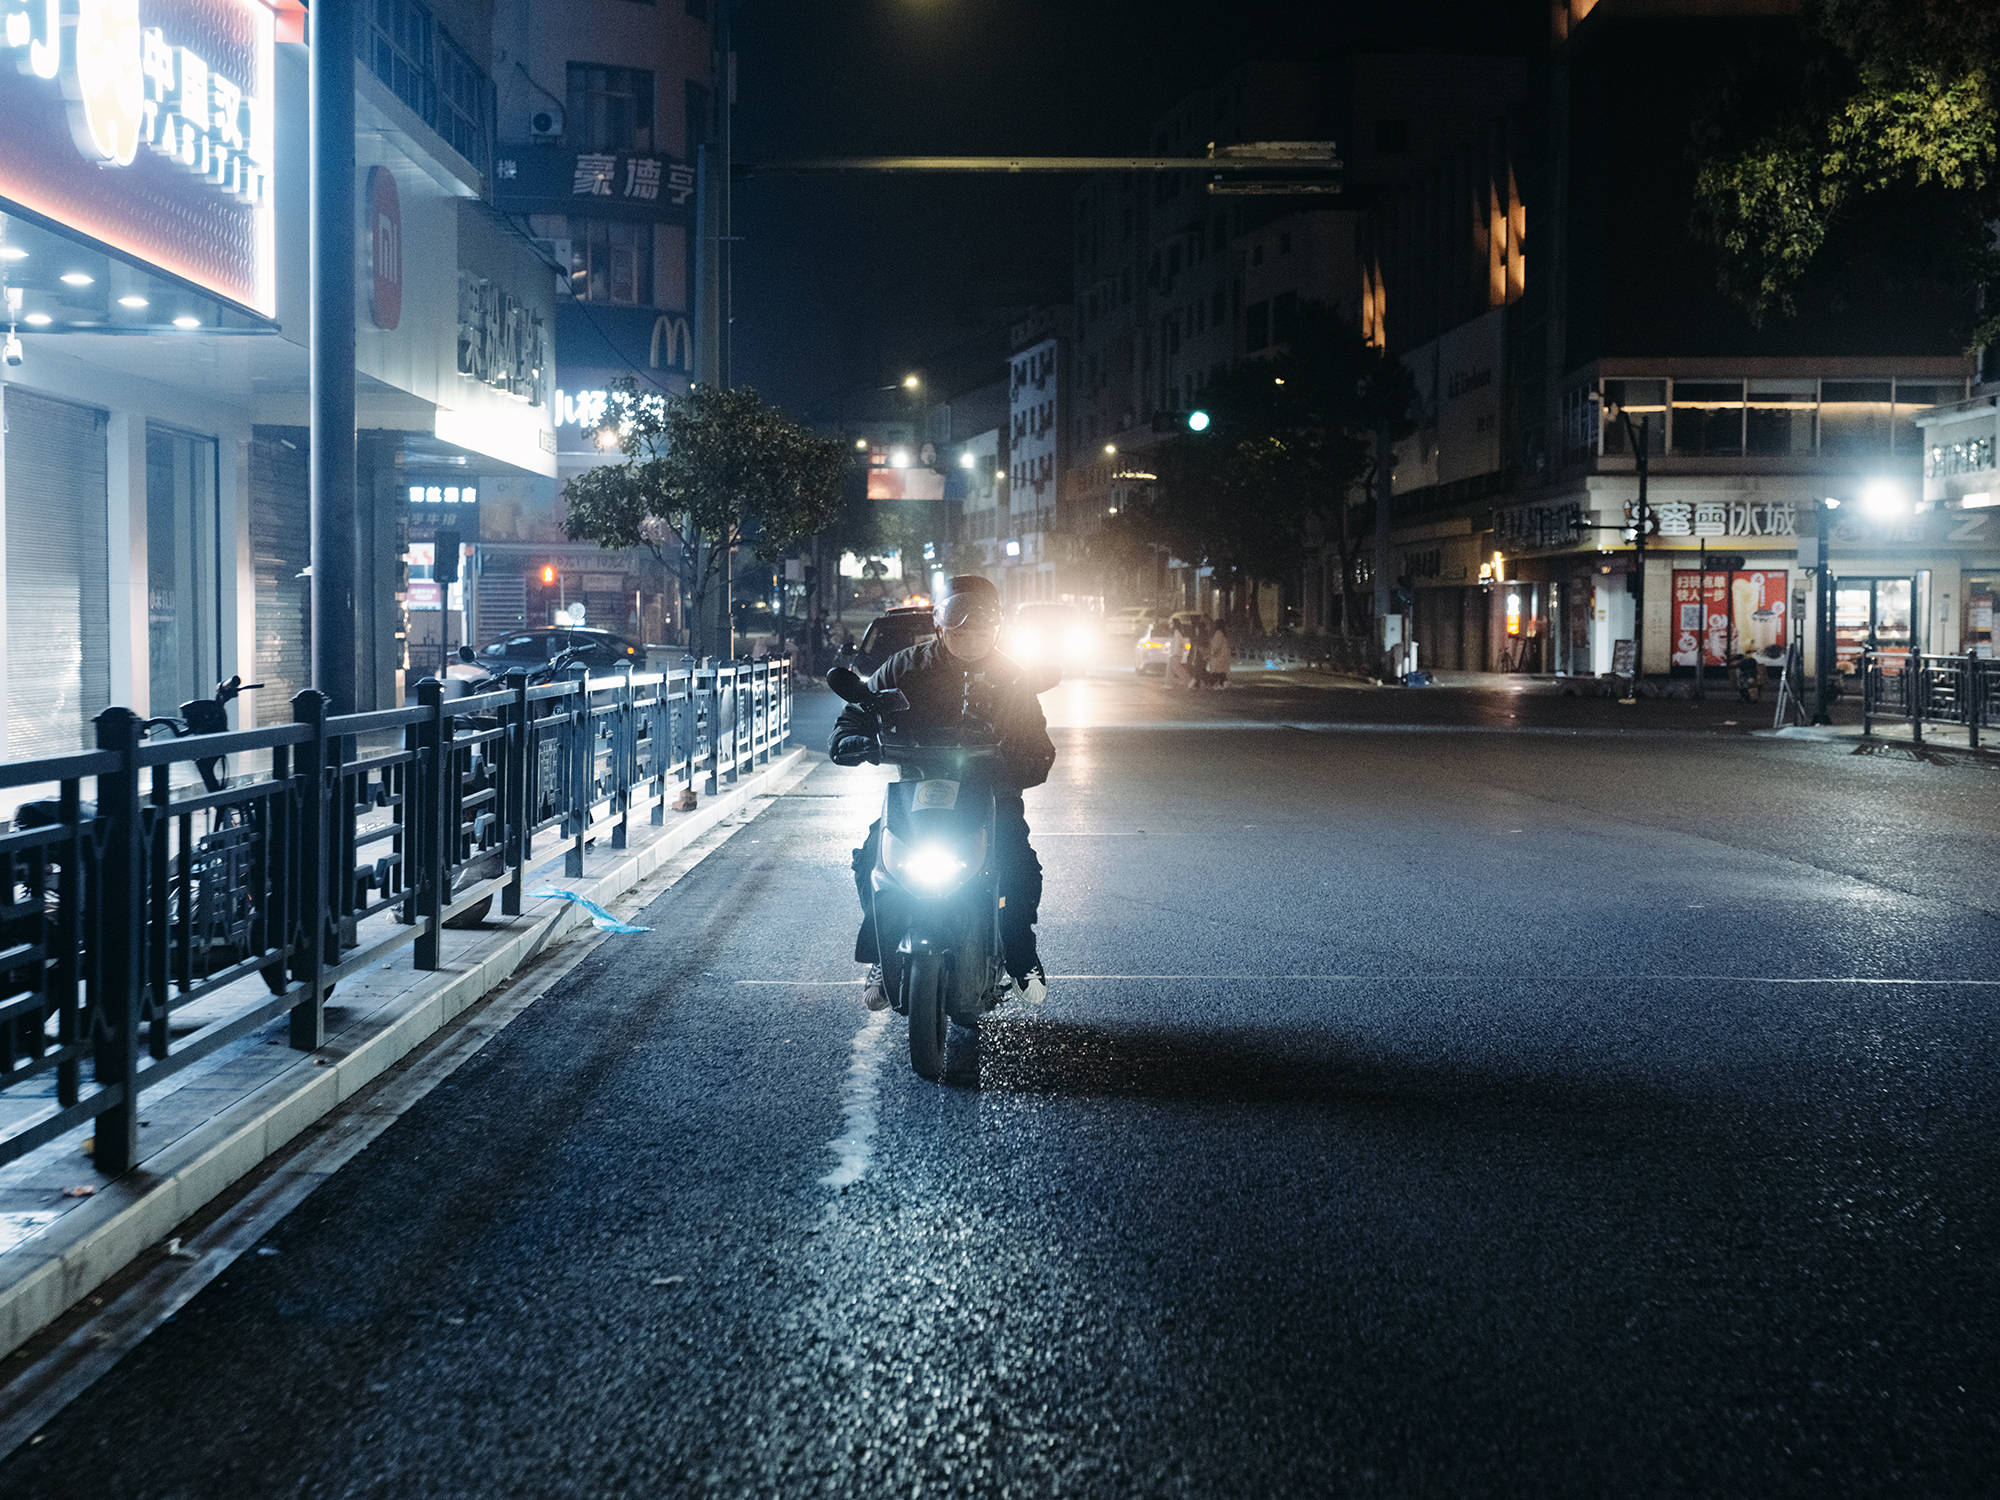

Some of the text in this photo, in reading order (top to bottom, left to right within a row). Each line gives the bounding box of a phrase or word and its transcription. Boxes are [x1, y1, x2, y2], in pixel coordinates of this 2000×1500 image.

[1657, 500, 1797, 537] 蜜雪冰城
[1676, 589, 1726, 602] 快人一步
